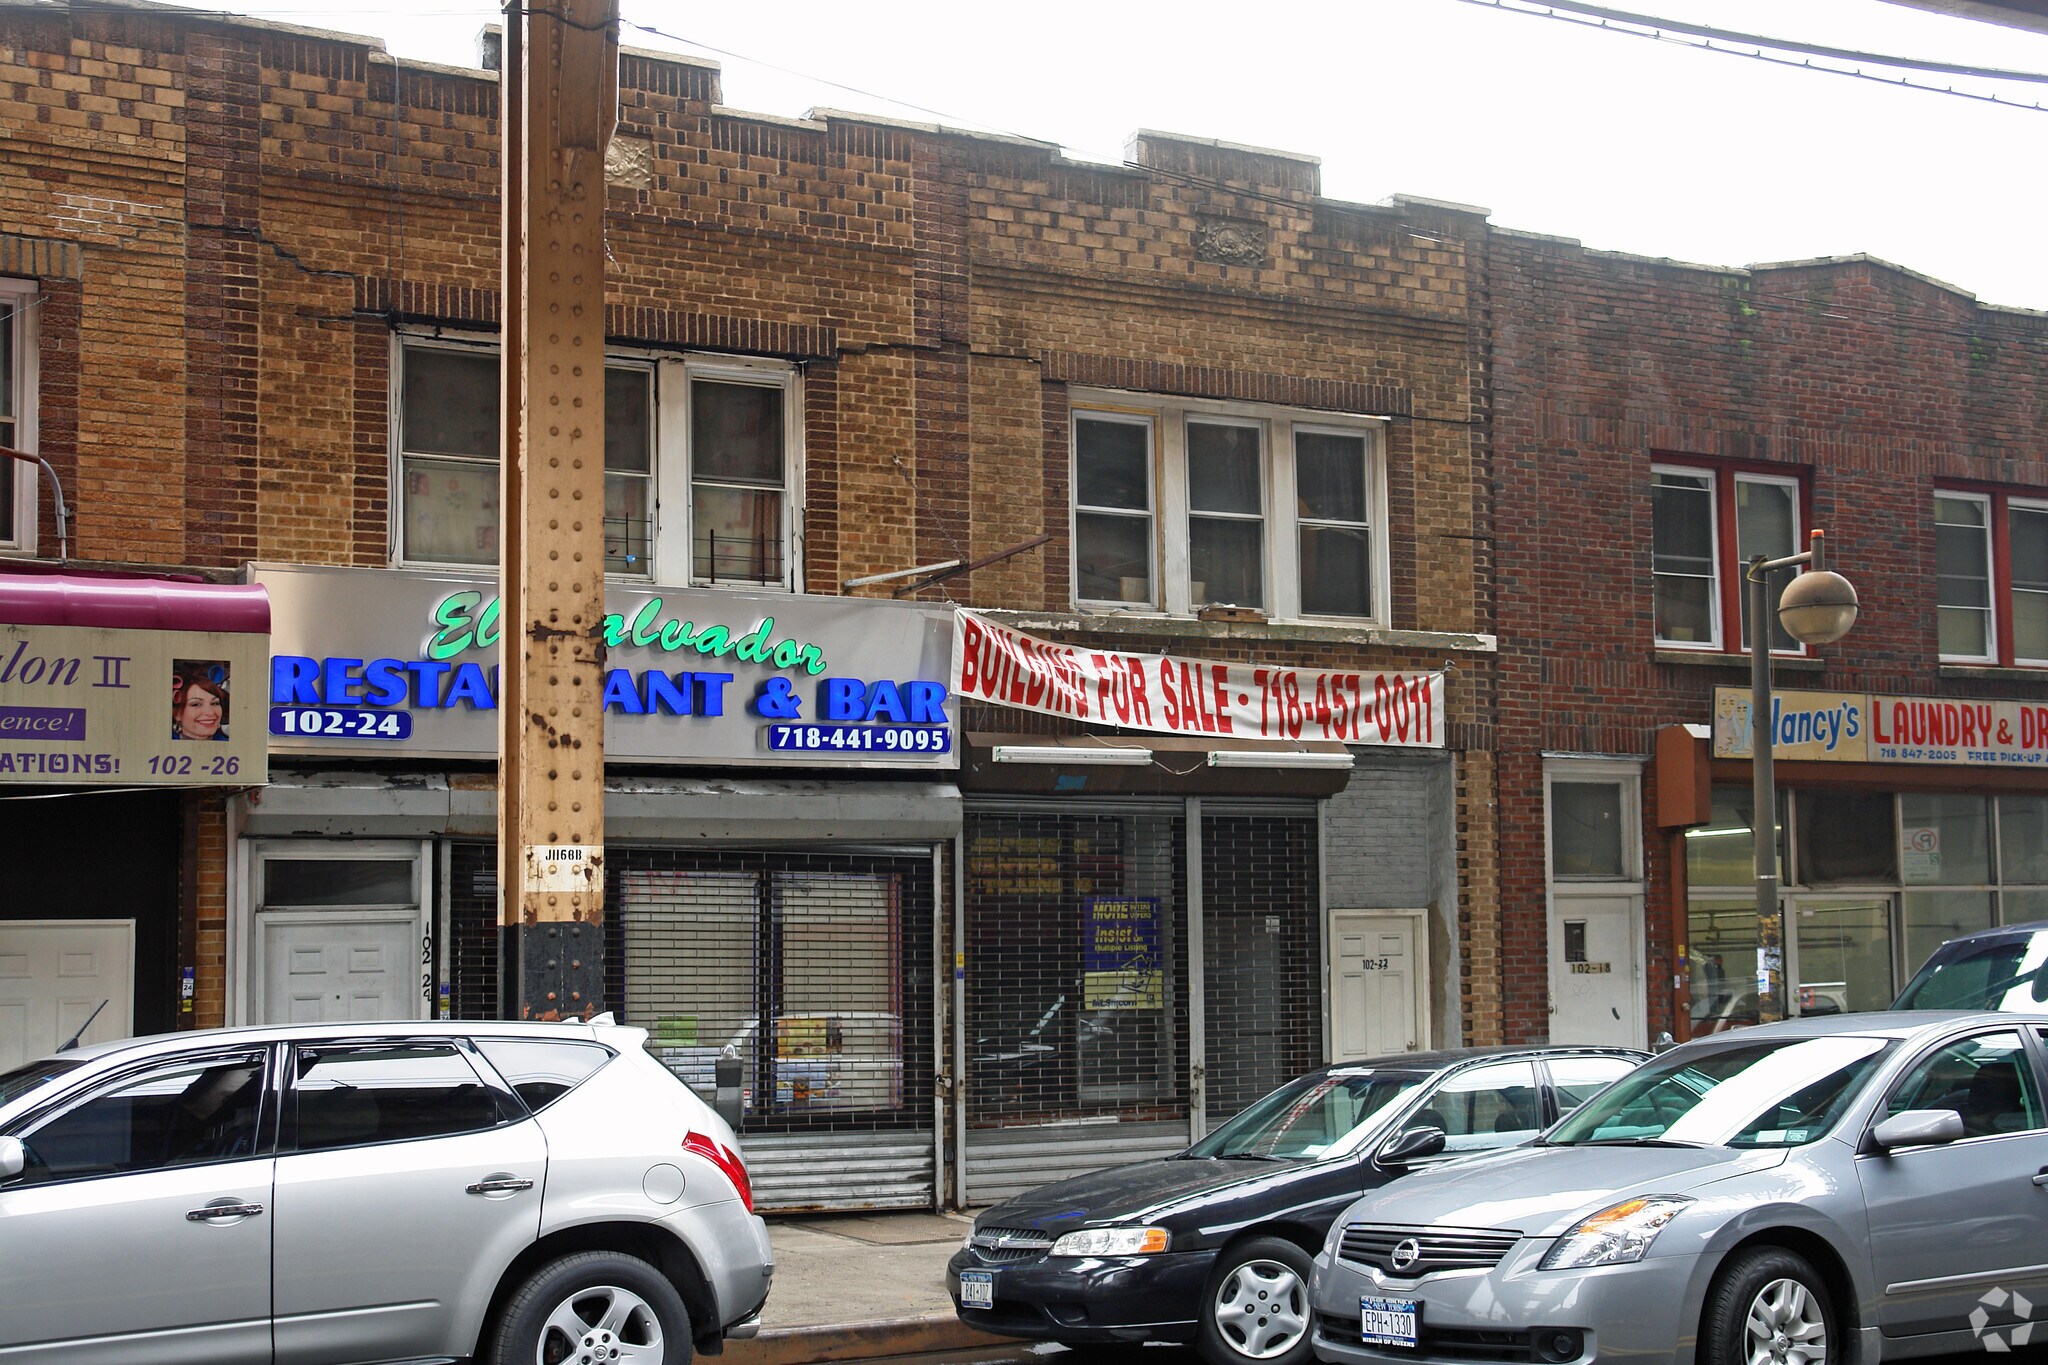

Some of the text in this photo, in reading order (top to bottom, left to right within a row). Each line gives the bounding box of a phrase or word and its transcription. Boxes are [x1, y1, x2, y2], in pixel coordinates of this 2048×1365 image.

[0, 640, 131, 688] lon II
[271, 655, 949, 723] RESTAANT & BAR
[961, 617, 1433, 744] BUILDING FOR SALE 718-457-0011
[0, 712, 75, 732] ence!
[280, 710, 400, 736] 102-24
[1872, 700, 1992, 748] LAUNDRY
[1996, 718, 2013, 746] &
[777, 727, 944, 750] 718-441-9095
[148, 755, 193, 775] 102
[1880, 748, 2042, 762] 718 847-2005 FREE PICK-UP
